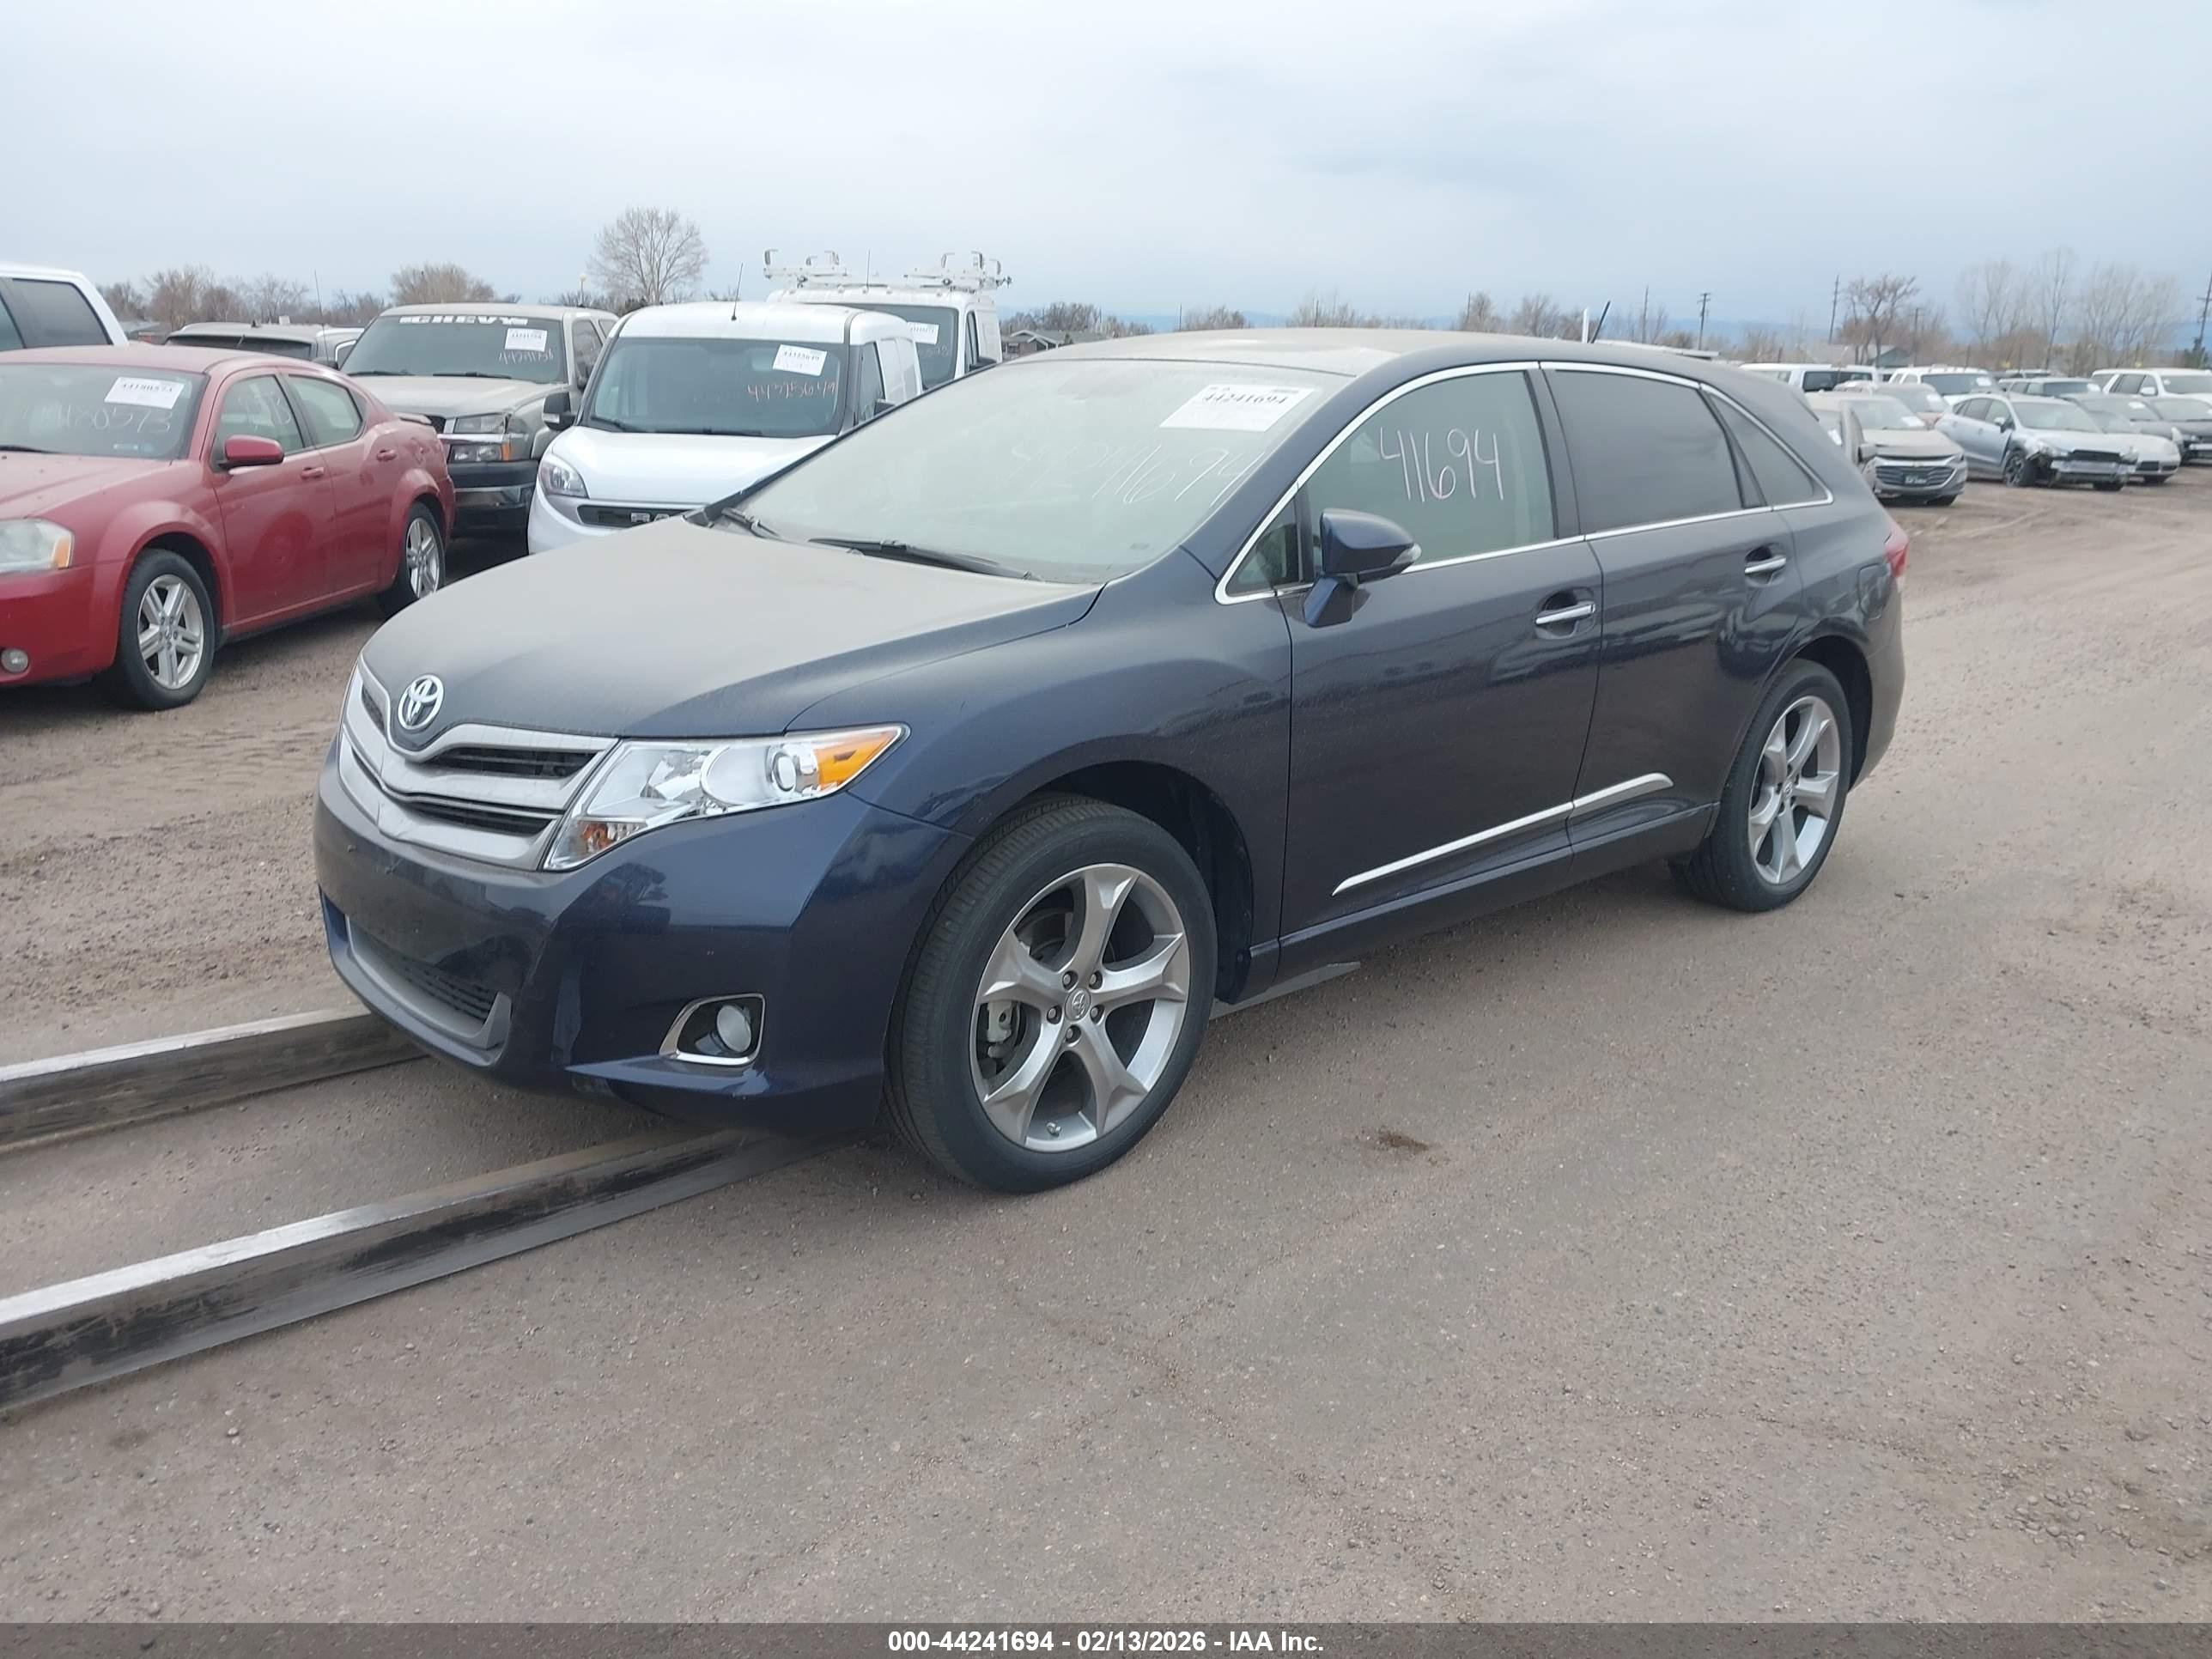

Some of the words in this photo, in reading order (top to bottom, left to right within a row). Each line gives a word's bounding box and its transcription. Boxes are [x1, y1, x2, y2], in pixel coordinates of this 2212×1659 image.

[411, 315, 517, 325] CHEVY
[1204, 392, 1289, 405] 44241694
[1379, 426, 1504, 503] 41694
